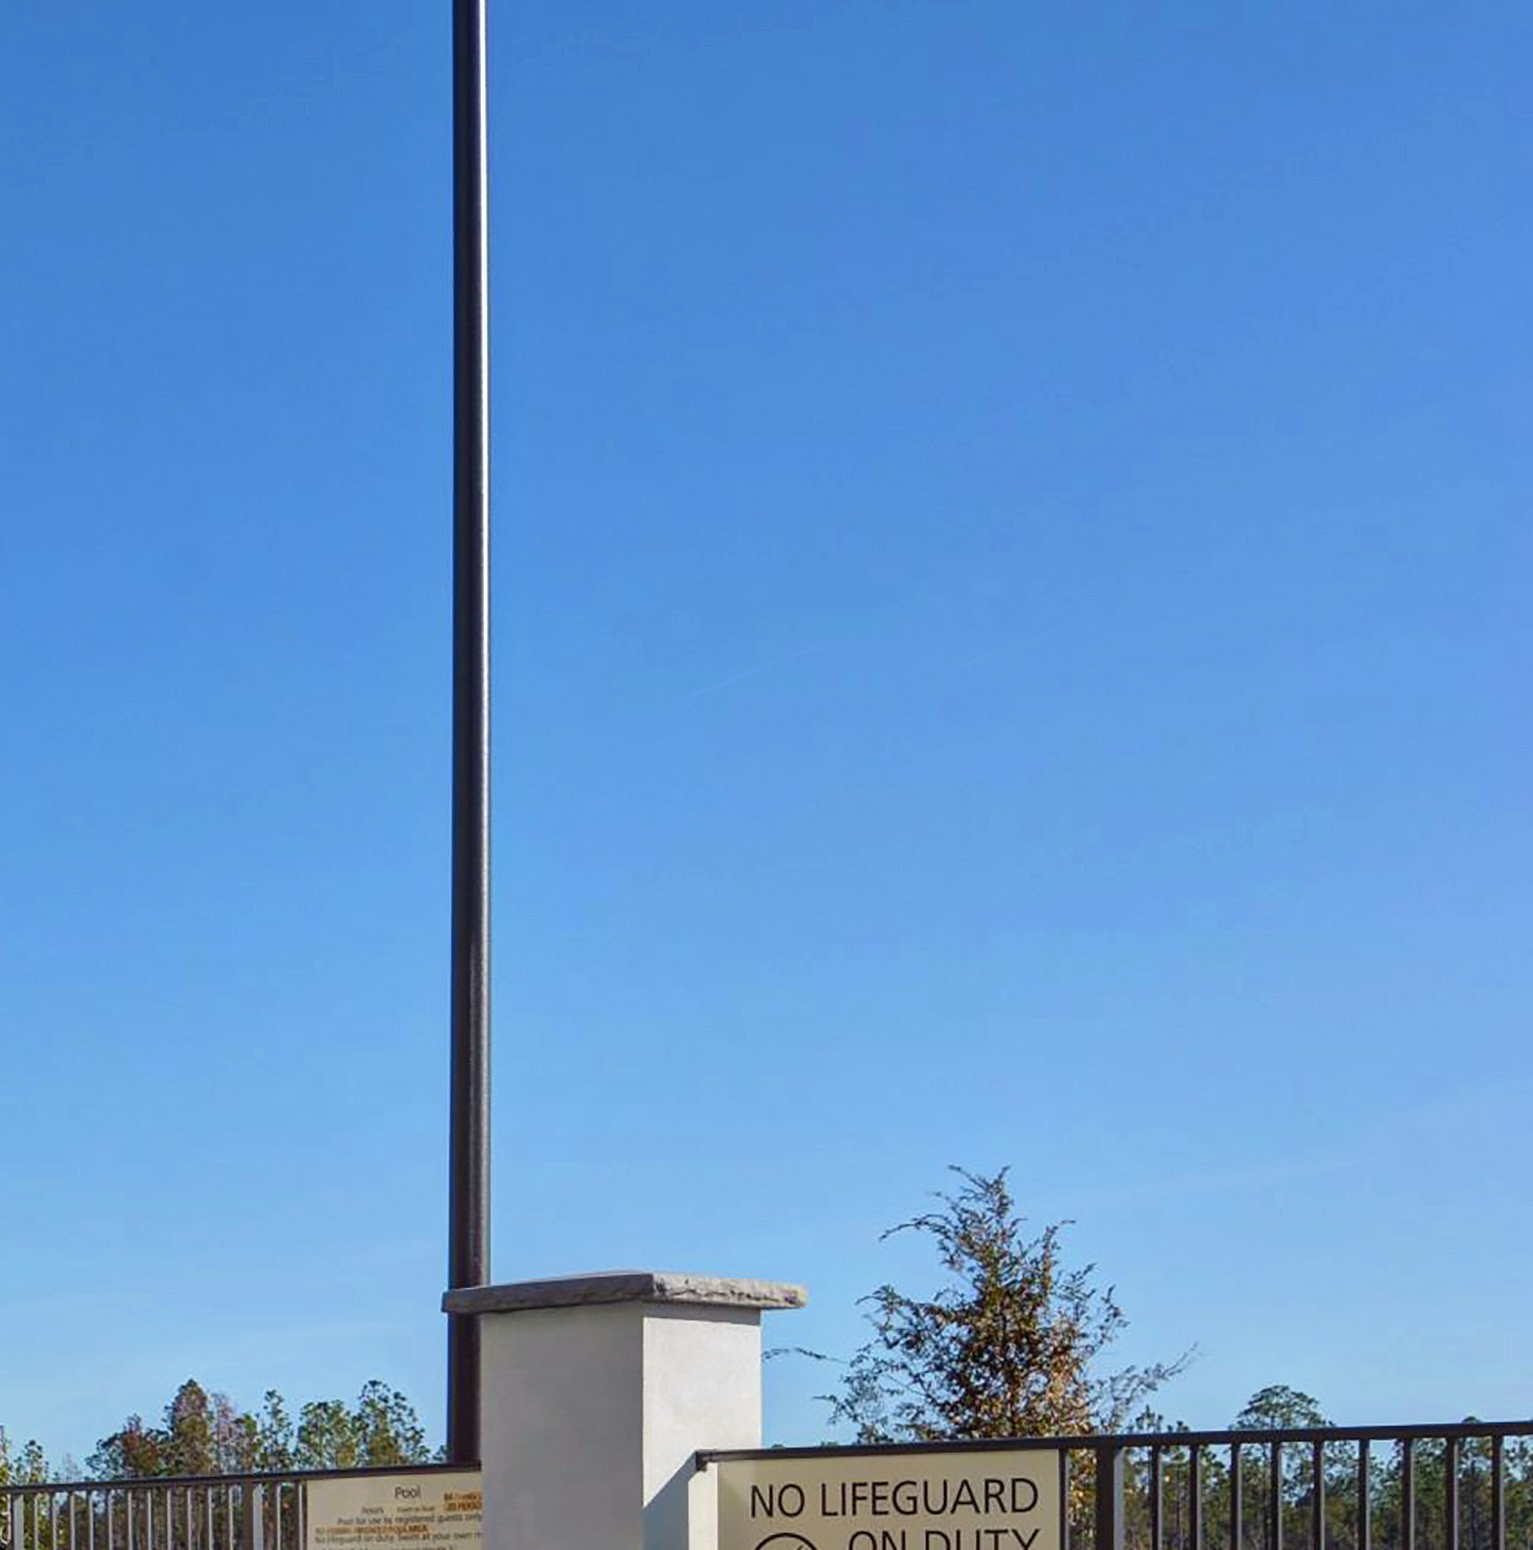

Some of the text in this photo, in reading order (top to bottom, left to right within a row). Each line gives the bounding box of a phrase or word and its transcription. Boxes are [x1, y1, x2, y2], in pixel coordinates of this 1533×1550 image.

[395, 1486, 421, 1499] Pool
[751, 1477, 1039, 1518] NO LIFEGUARD
